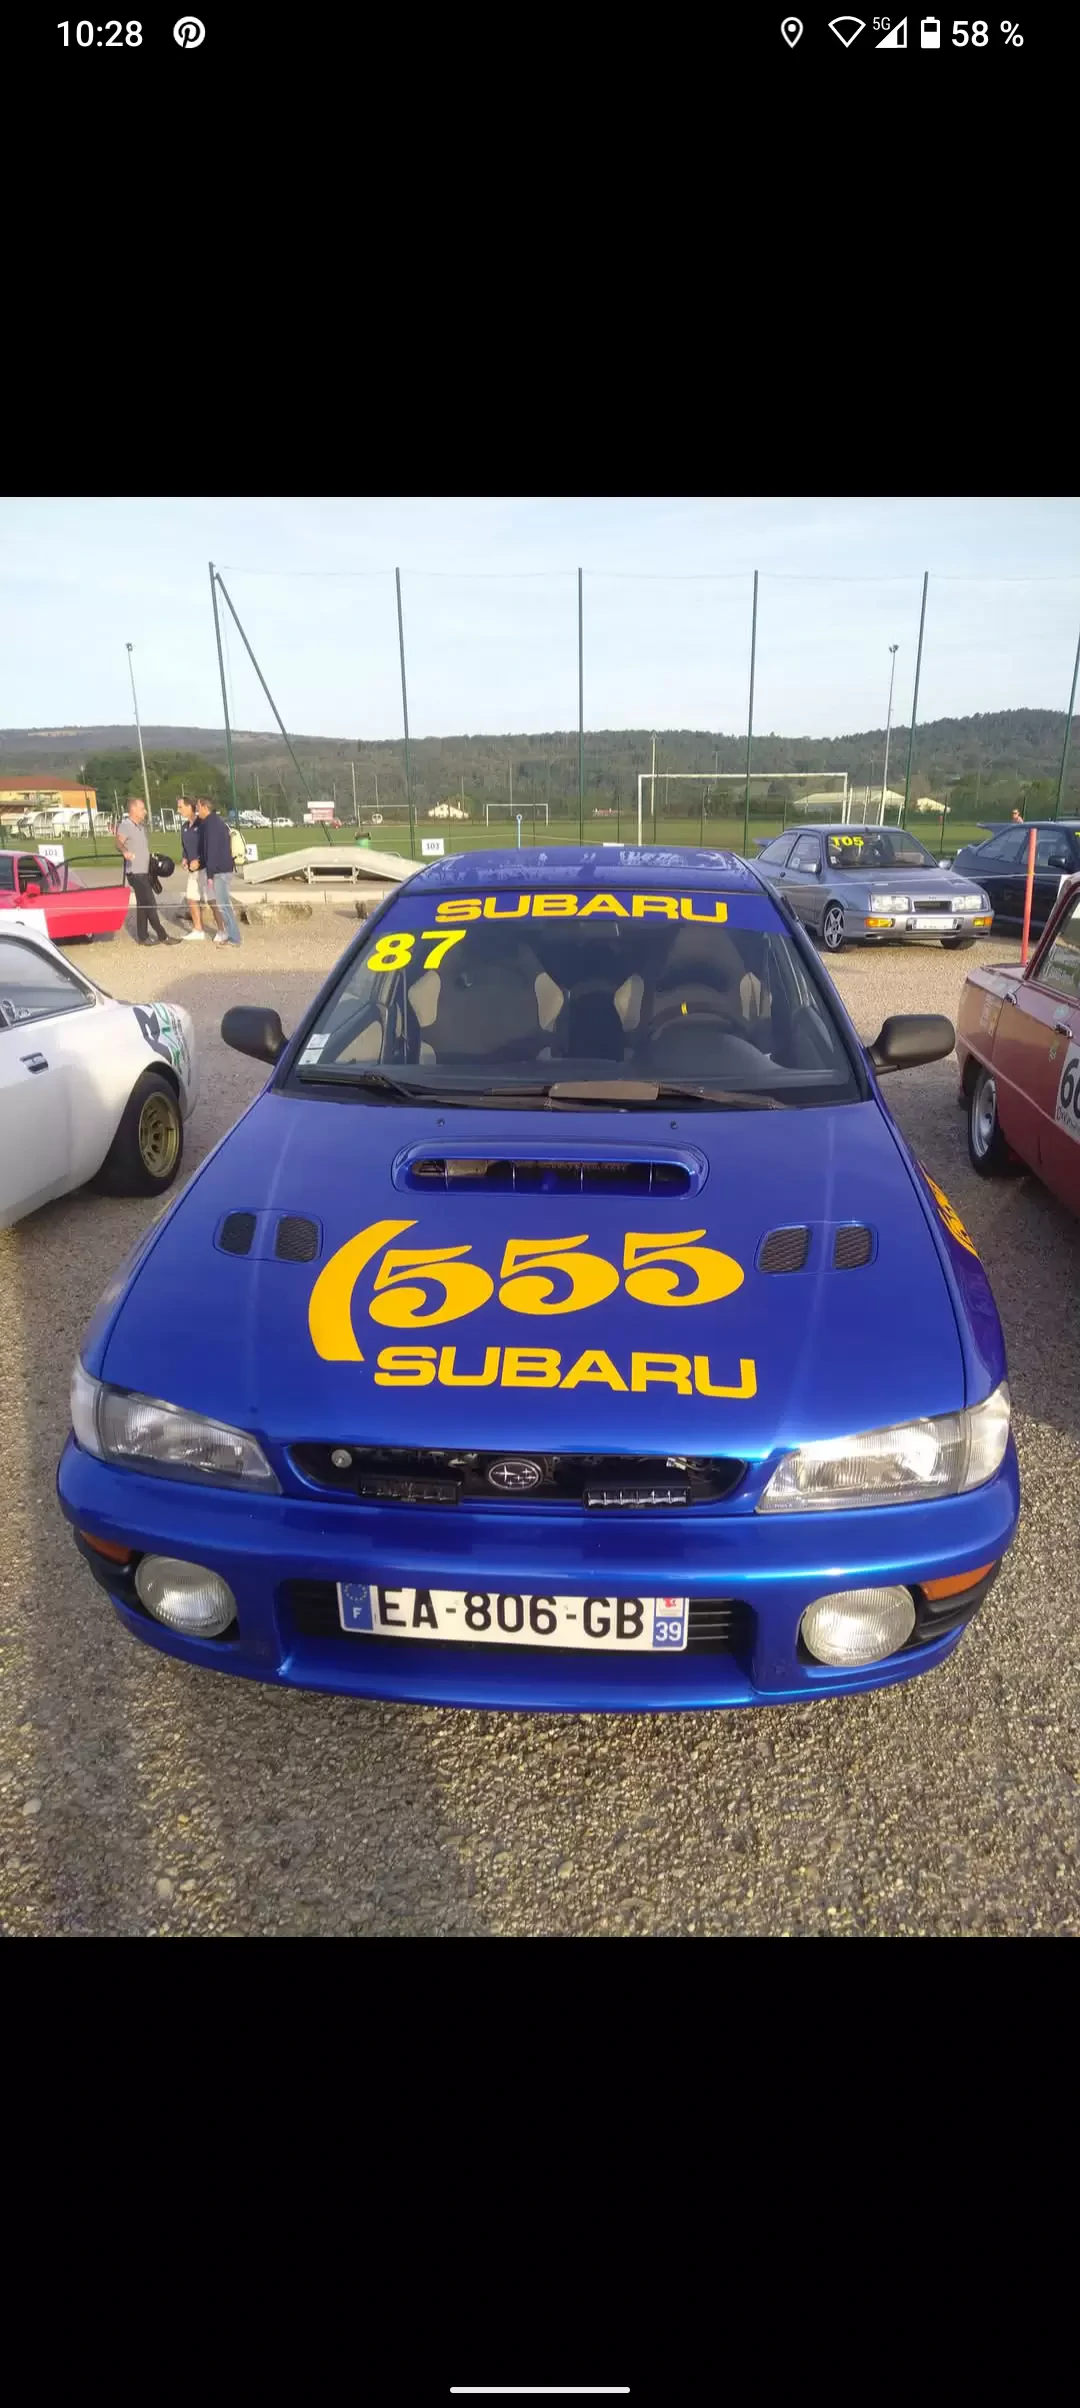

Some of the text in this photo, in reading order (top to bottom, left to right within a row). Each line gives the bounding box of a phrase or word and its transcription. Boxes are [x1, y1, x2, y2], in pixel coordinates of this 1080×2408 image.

[435, 893, 728, 923] SUBARU
[367, 929, 467, 973] 87
[374, 1346, 757, 1399] SUBARU
[352, 1607, 362, 1620] F
[379, 1588, 645, 1640] EA-806-GB
[655, 1621, 682, 1642] 39
